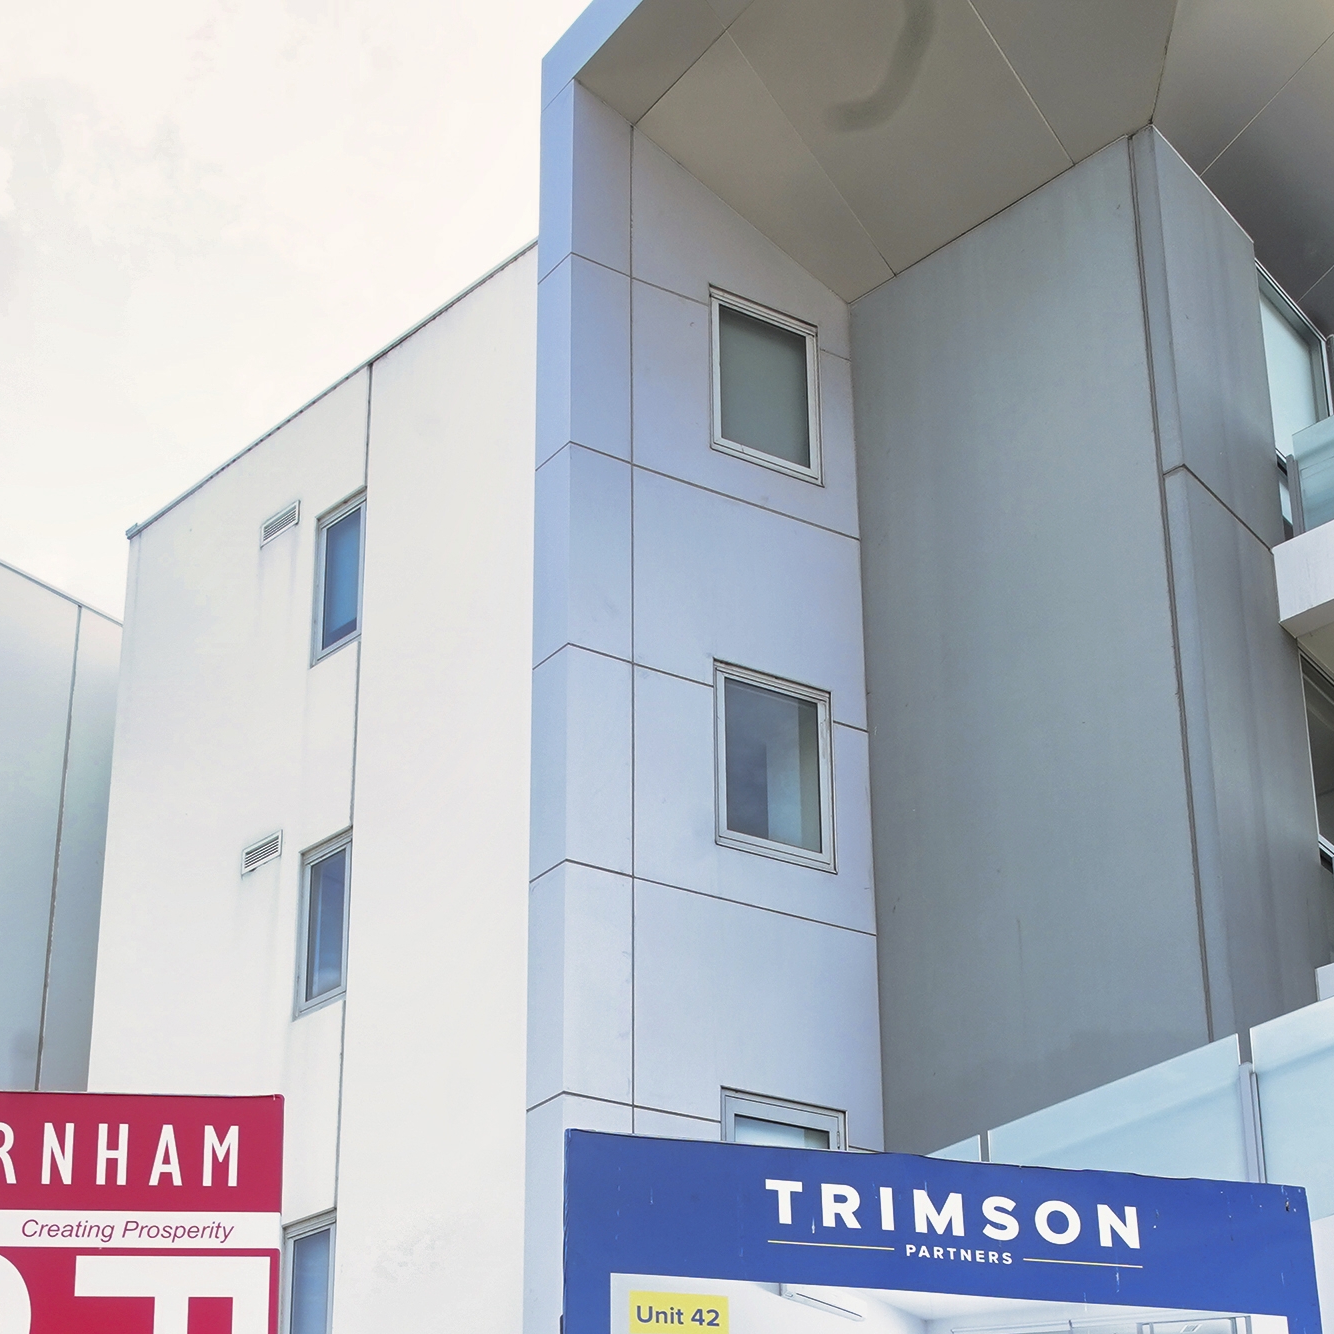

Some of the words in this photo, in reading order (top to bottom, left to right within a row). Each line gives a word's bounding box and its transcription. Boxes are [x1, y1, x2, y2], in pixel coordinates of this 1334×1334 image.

[765, 1178, 1140, 1249] TRIMSON
[21, 1218, 115, 1242] Creating
[121, 1220, 234, 1243] Prosperity
[905, 1244, 1012, 1265] PARTNERS
[636, 1305, 684, 1325] Unit
[690, 1308, 720, 1327] 42
